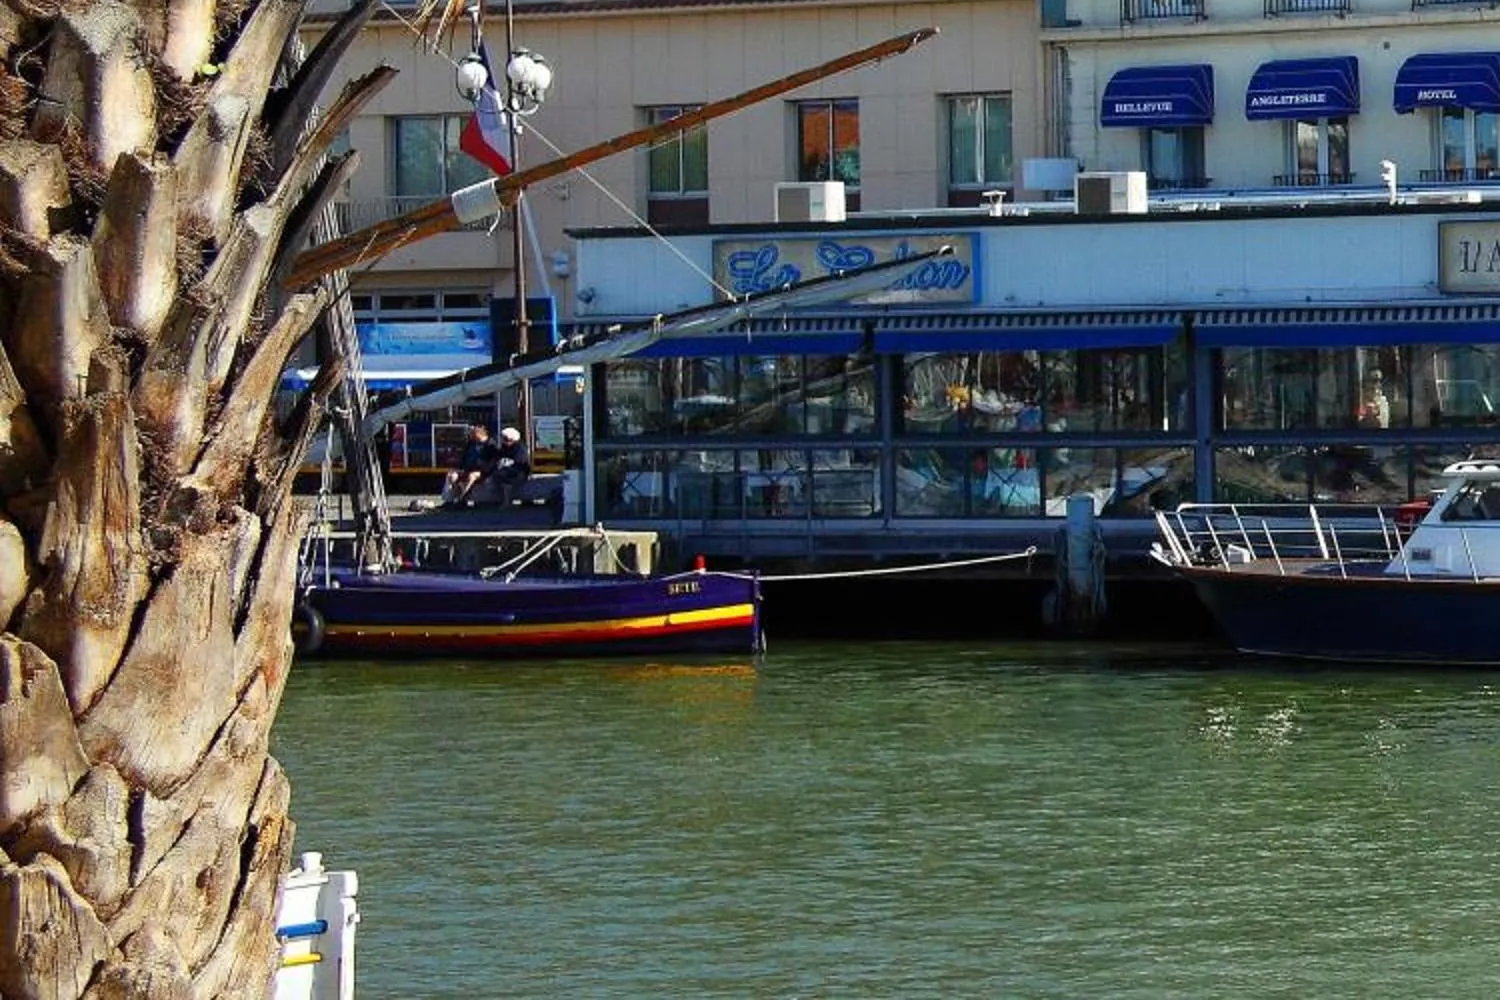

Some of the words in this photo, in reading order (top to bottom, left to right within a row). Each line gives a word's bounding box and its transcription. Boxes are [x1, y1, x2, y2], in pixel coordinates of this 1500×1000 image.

[1251, 93, 1326, 106] ANGLETERRE
[1418, 89, 1457, 101] HOTEL
[1115, 102, 1172, 113] BELLEVUE
